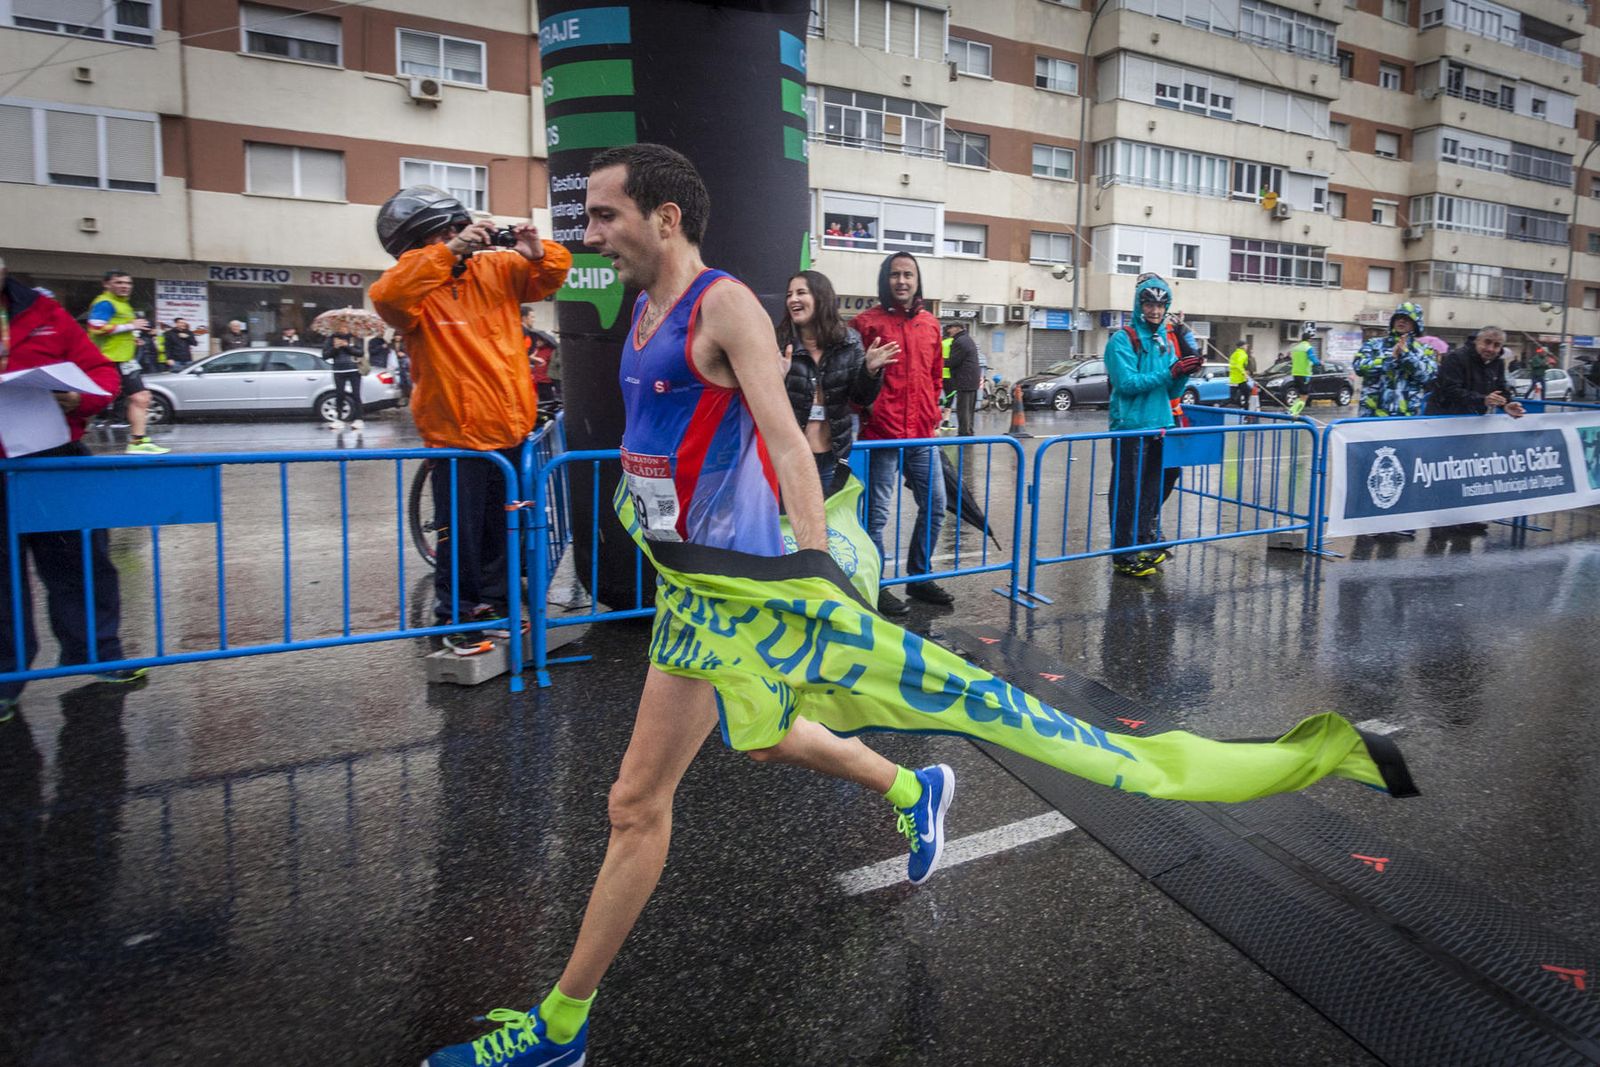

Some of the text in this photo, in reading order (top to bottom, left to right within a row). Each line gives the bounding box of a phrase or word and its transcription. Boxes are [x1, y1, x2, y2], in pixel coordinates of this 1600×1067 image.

[209, 266, 362, 286] RASTRO RETO
[567, 267, 616, 289] CHIP
[1412, 446, 1562, 488] Ayuntamiento de Cádiz
[1494, 477, 1528, 493] Municipal
